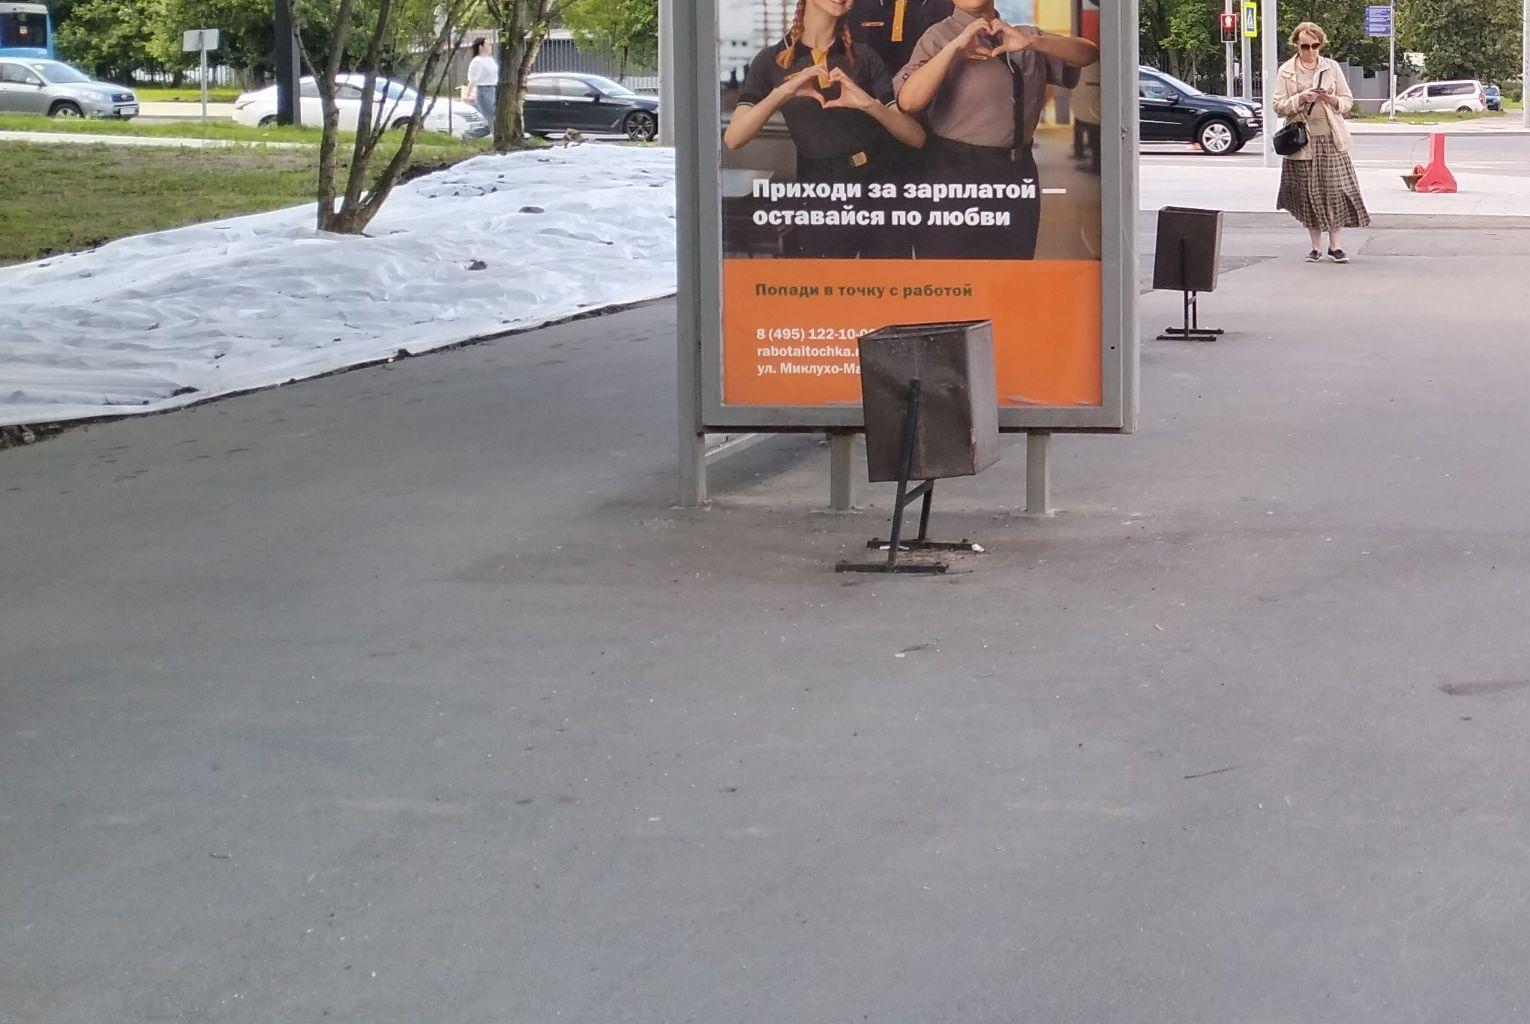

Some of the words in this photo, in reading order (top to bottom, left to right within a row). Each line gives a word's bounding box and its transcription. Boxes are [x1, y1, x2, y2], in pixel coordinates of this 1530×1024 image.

[752, 179, 862, 201] Приходи
[868, 184, 896, 198] за
[903, 178, 1036, 202] зарплатой
[752, 205, 884, 226] оставайся
[891, 210, 922, 226] по
[927, 207, 1010, 226] любви
[755, 283, 819, 298] Попади
[824, 286, 833, 295] в
[838, 285, 885, 298] точку
[889, 286, 898, 296] с
[903, 283, 972, 299] работой
[756, 328, 765, 340] 8
[769, 328, 805, 341] (495)
[757, 364, 777, 376] ул.
